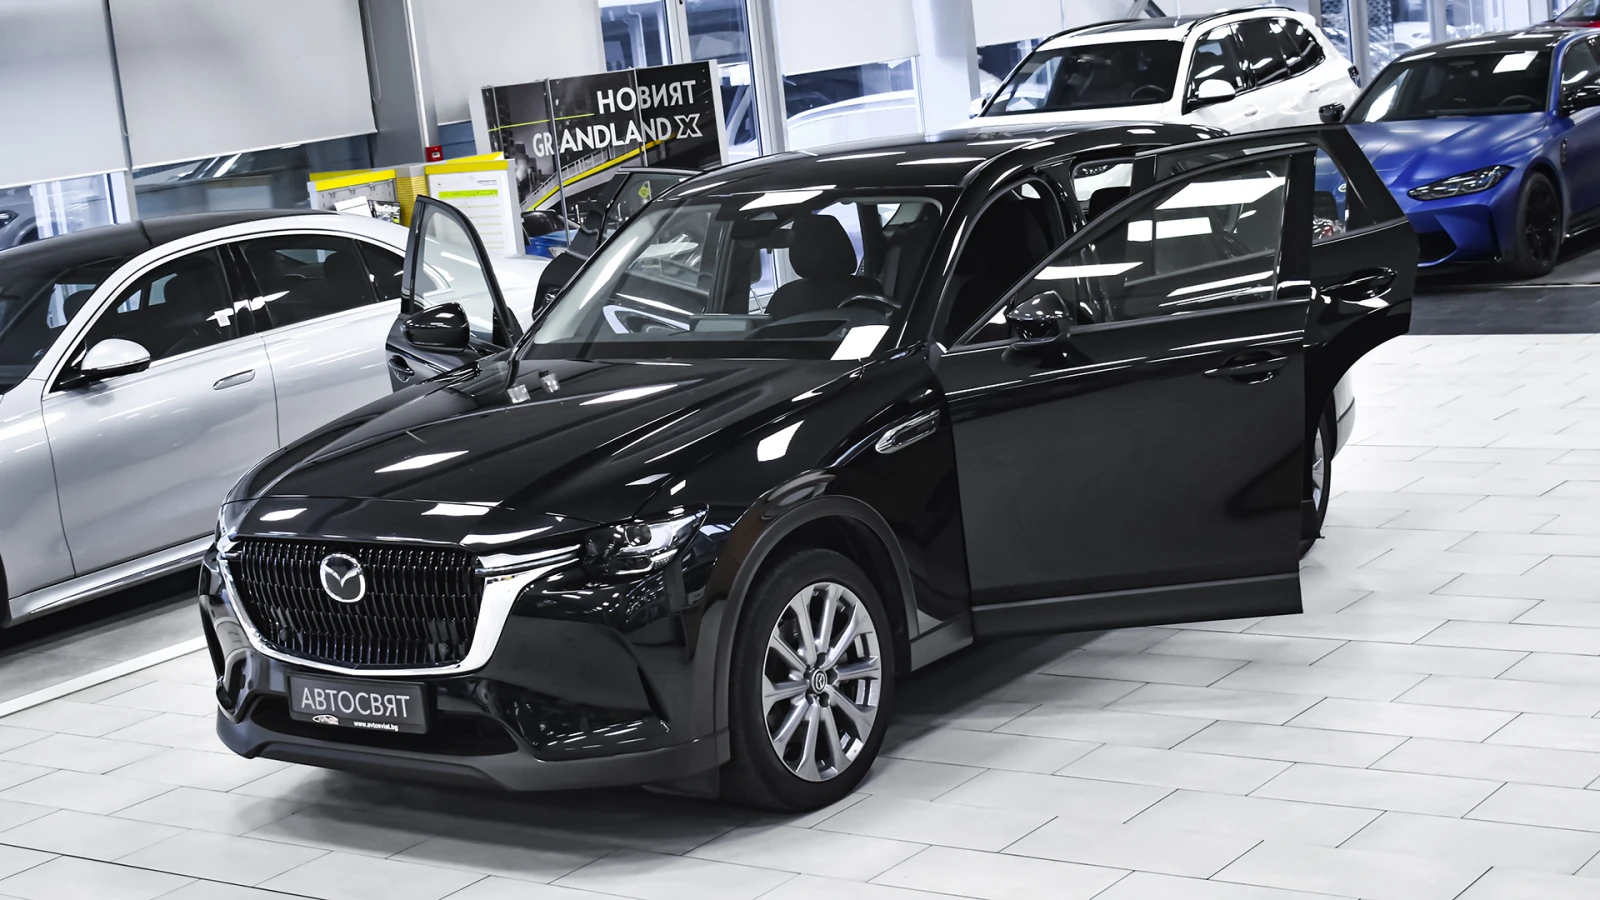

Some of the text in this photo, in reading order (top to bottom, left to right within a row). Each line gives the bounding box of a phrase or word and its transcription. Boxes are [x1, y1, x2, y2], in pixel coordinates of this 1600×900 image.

[597, 80, 696, 115] НОВИЯТ
[532, 117, 672, 158] GRANDLAND
[301, 687, 410, 718] АВТОСВЯТ
